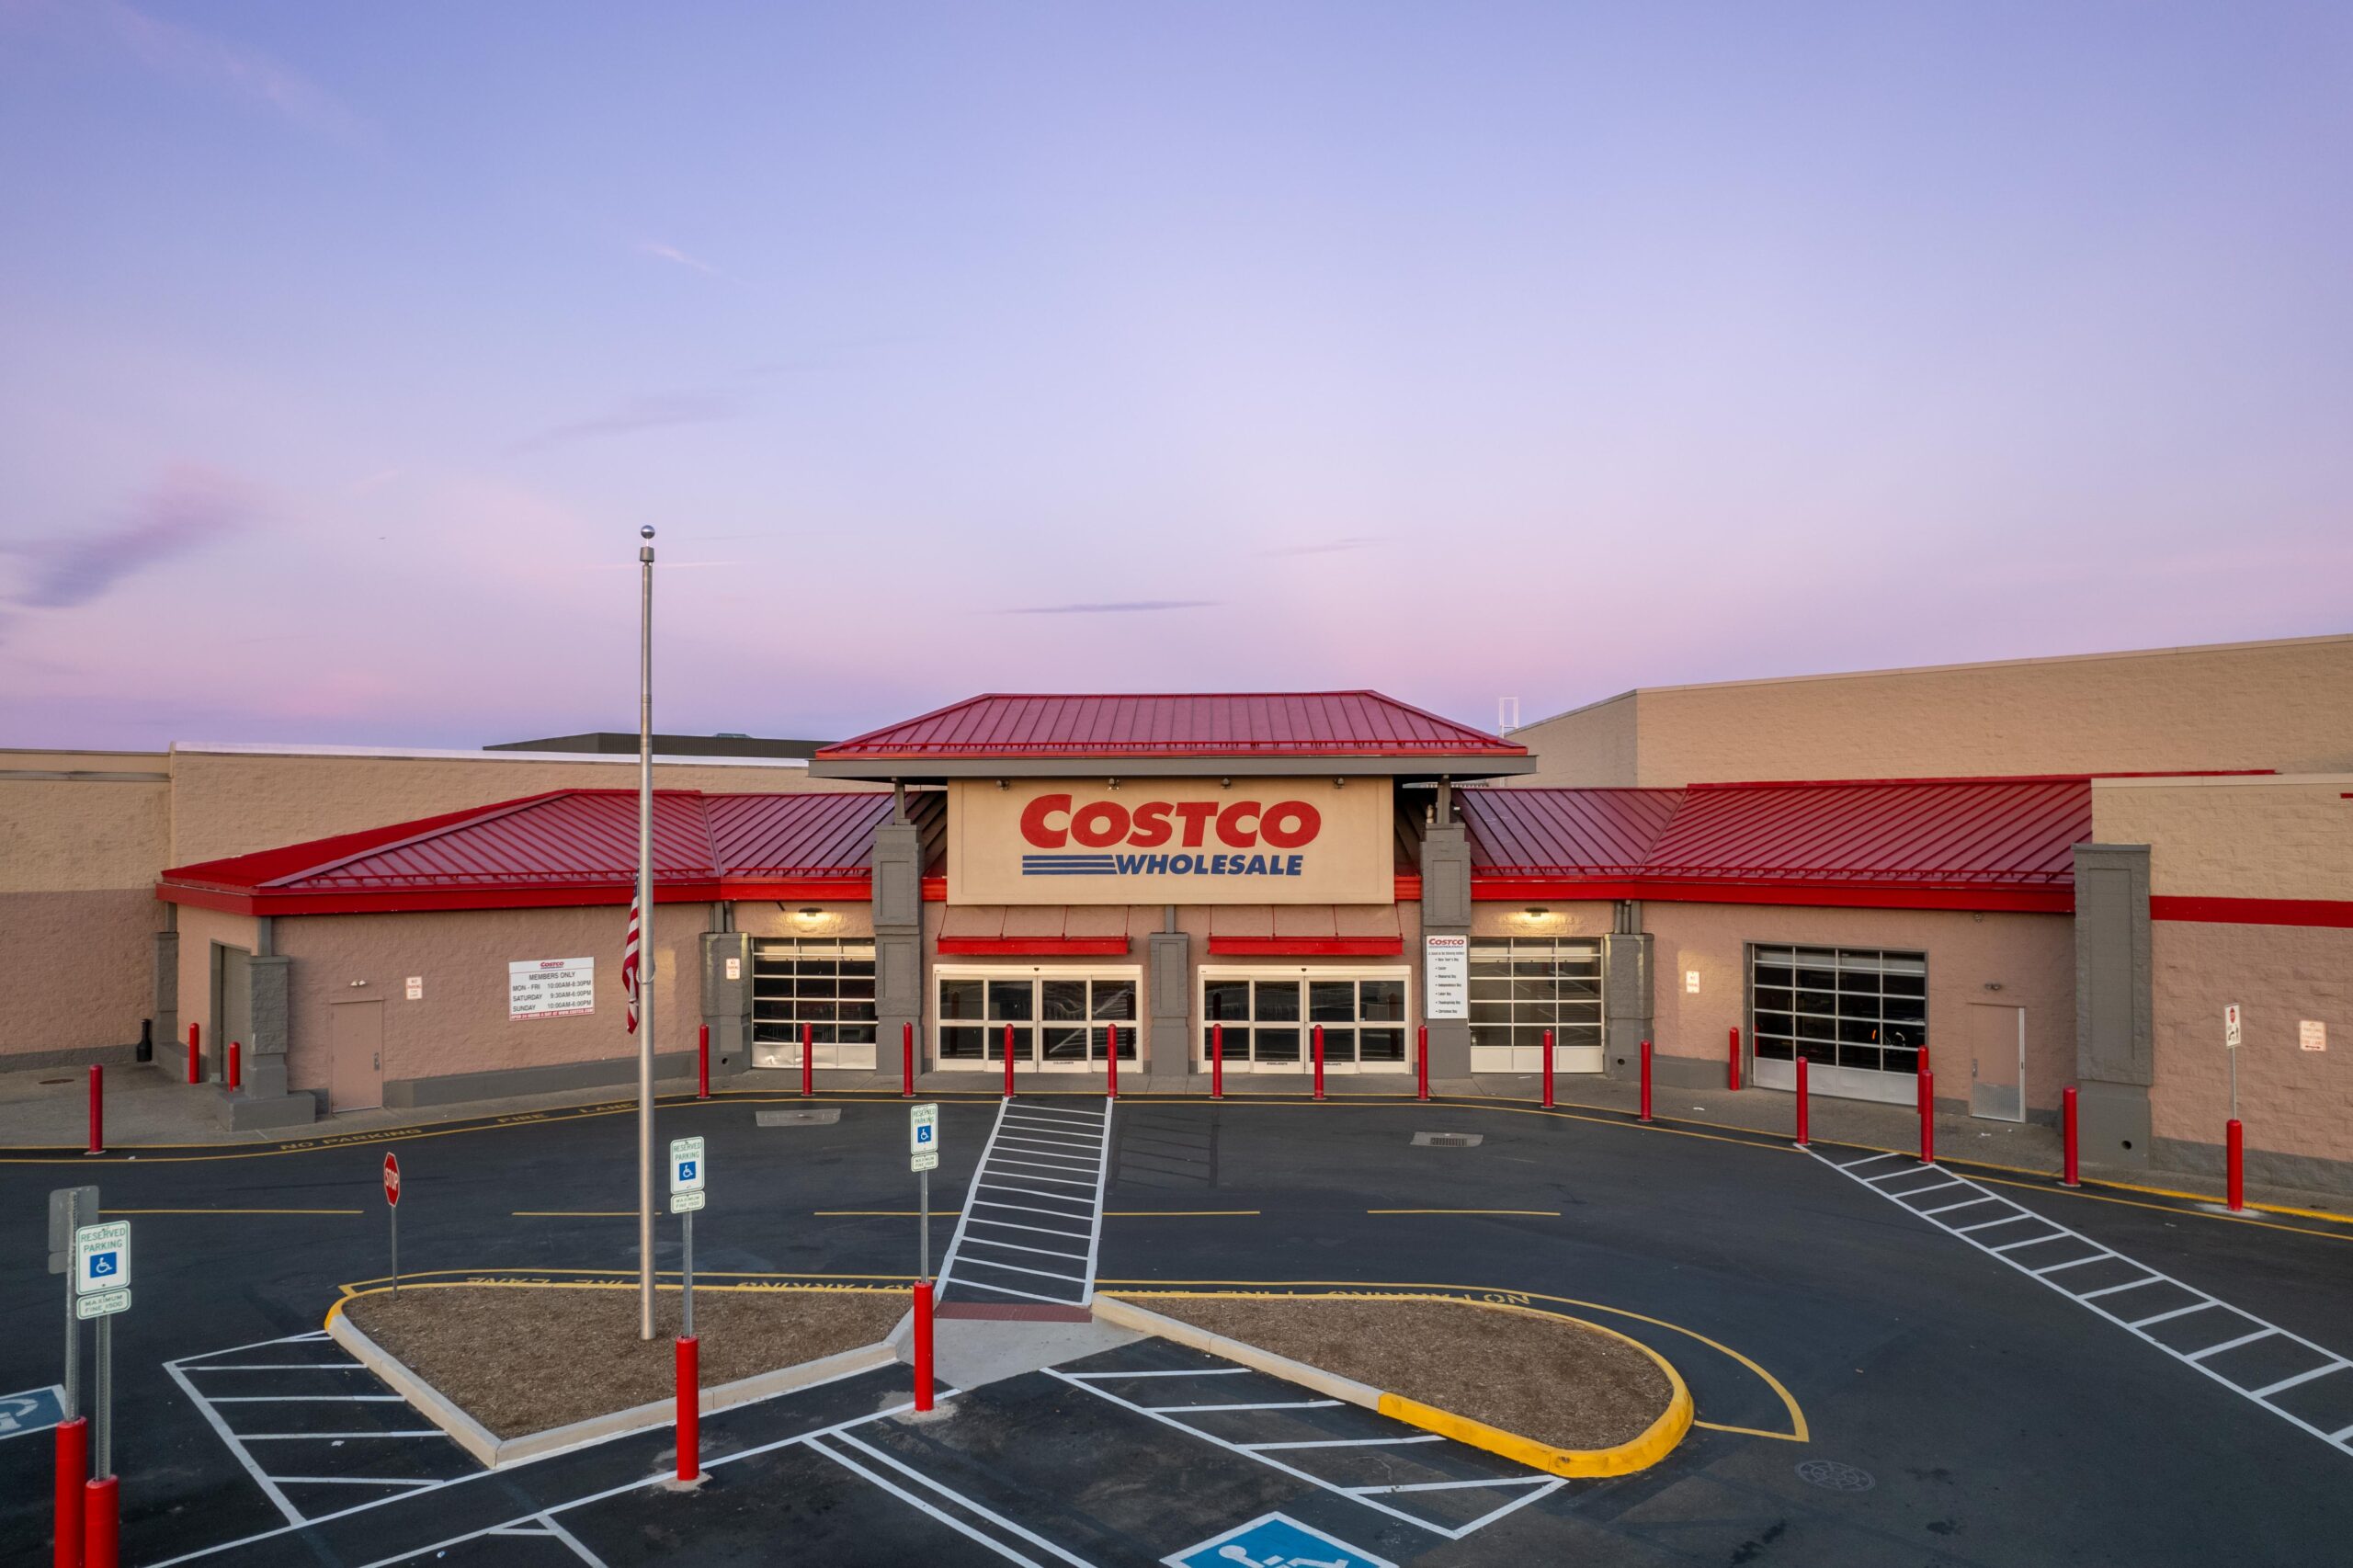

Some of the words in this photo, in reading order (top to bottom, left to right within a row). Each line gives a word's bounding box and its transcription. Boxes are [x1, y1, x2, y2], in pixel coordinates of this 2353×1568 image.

[1020, 794, 1321, 848] COSTCO
[1115, 854, 1303, 876] WHOLESALE
[513, 994, 542, 1002] SATURDAY
[280, 1142, 313, 1150] NO
[323, 1129, 422, 1144] PARKING
[497, 1113, 549, 1123] FIRE
[578, 1103, 635, 1113] LANE
[674, 1142, 700, 1153] RESERVED
[676, 1151, 699, 1160] PARKING
[386, 1167, 398, 1190] STOP
[81, 1228, 126, 1244] RESERVED
[84, 1239, 122, 1253] PARKING
[85, 1294, 123, 1306] MAXIMUM
[85, 1304, 103, 1313] FINE
